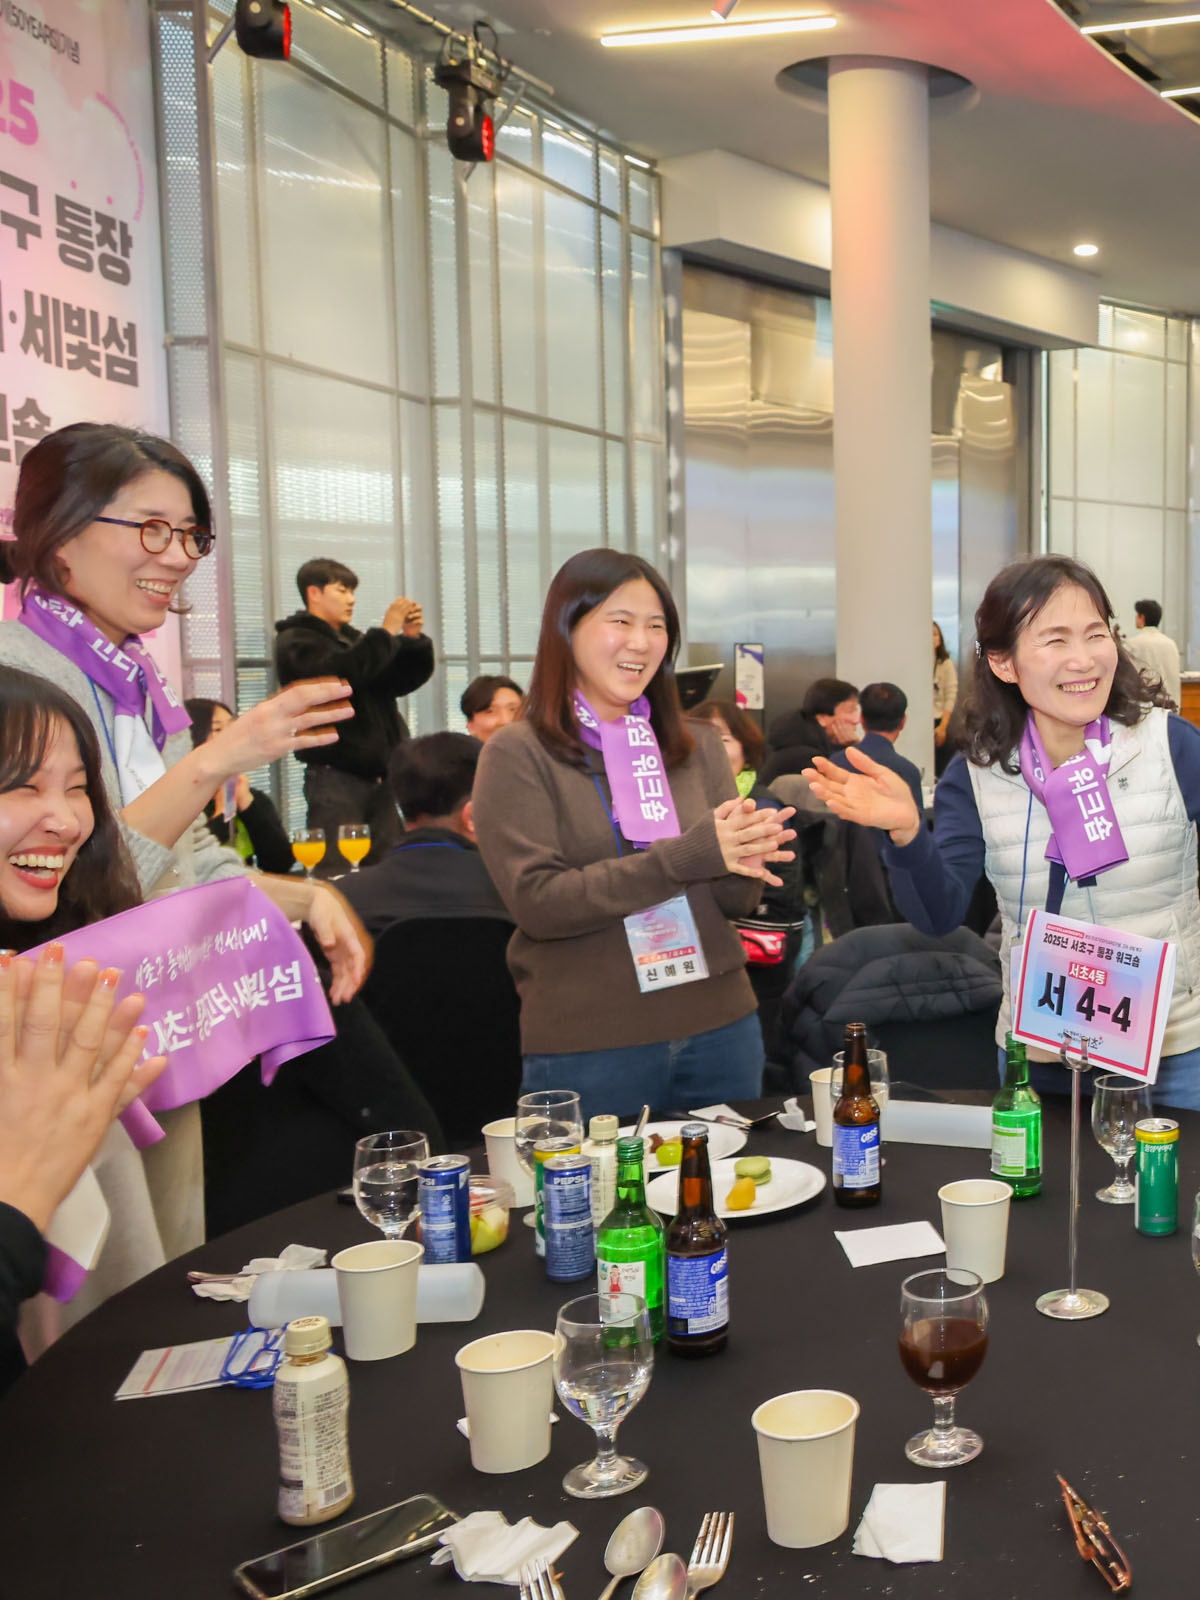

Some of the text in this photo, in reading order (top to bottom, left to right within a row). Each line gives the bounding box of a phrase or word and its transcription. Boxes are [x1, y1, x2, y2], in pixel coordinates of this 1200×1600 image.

[0, 79, 39, 146] 5
[55, 194, 133, 286] 통장
[631, 754, 670, 822] 워크숍
[1068, 767, 1114, 843] 워크숍
[1042, 932, 1069, 950] 2025년
[1070, 939, 1095, 955] 서초구
[1097, 945, 1114, 961] 통장
[1115, 950, 1141, 969] 워크숍
[1069, 963, 1107, 985] 서초4동
[1037, 971, 1132, 1033] 서 4-4
